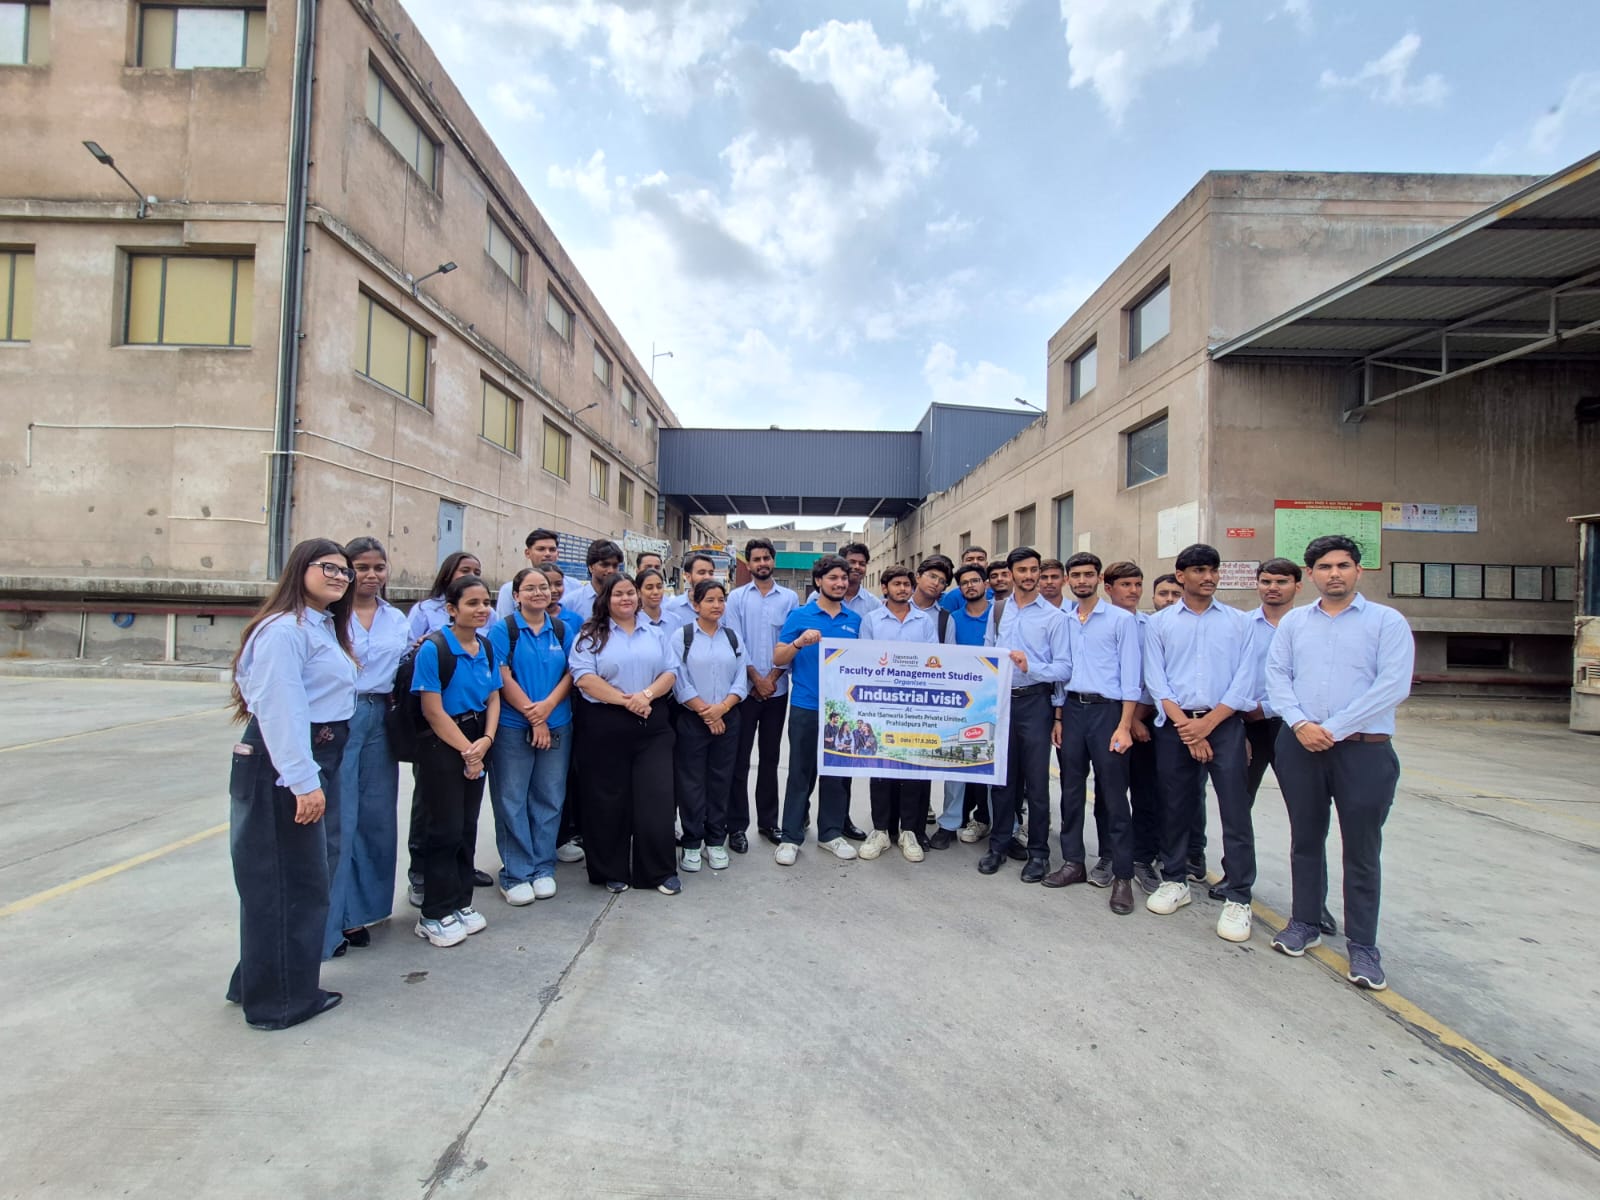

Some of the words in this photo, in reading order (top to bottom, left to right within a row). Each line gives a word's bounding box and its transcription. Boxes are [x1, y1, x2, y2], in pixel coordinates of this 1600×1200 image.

[839, 665, 873, 677] Faculty
[875, 666, 885, 676] of
[887, 668, 946, 680] Management
[948, 671, 983, 682] Studies
[858, 687, 928, 704] Industrial
[931, 692, 963, 706] visit
[924, 713, 943, 721] Private
[922, 721, 938, 729] Plant
